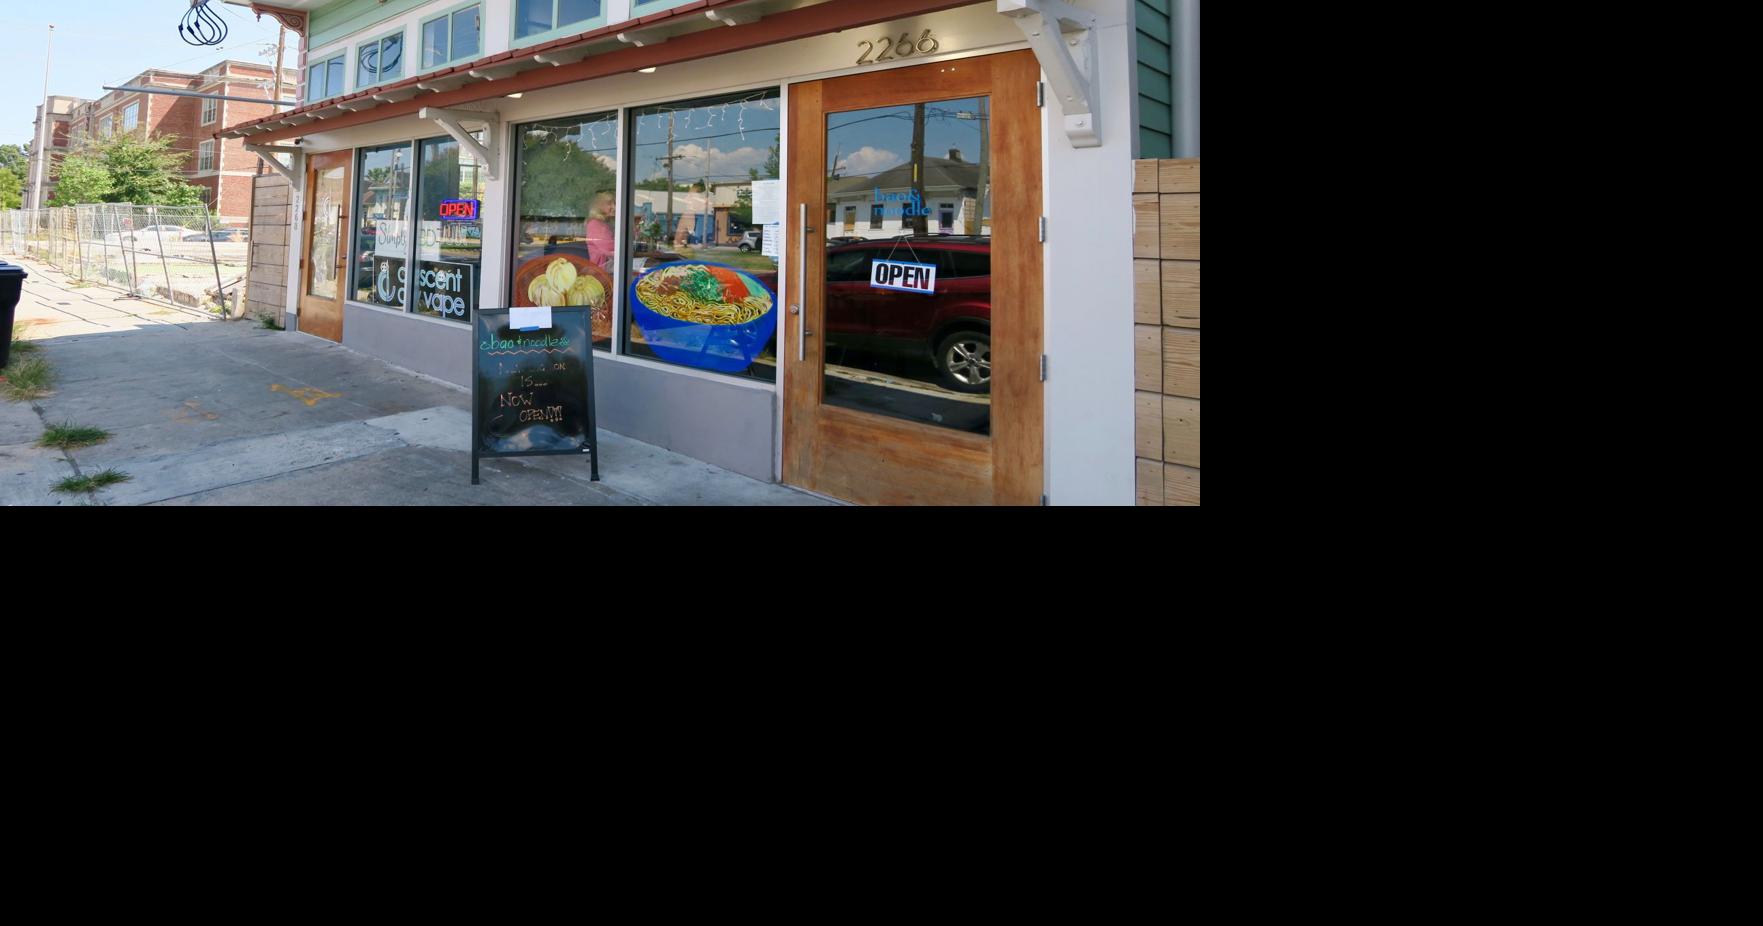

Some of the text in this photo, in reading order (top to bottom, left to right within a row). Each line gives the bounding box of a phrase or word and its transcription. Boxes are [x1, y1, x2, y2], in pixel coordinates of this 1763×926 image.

[856, 28, 939, 64] 2266
[440, 201, 474, 217] OPEN
[875, 201, 932, 216] noodle
[397, 266, 463, 293] cscent
[875, 263, 930, 290] OPEN
[423, 291, 465, 318] vape
[500, 392, 534, 407] NOW
[520, 405, 563, 422] OPEN!!!
